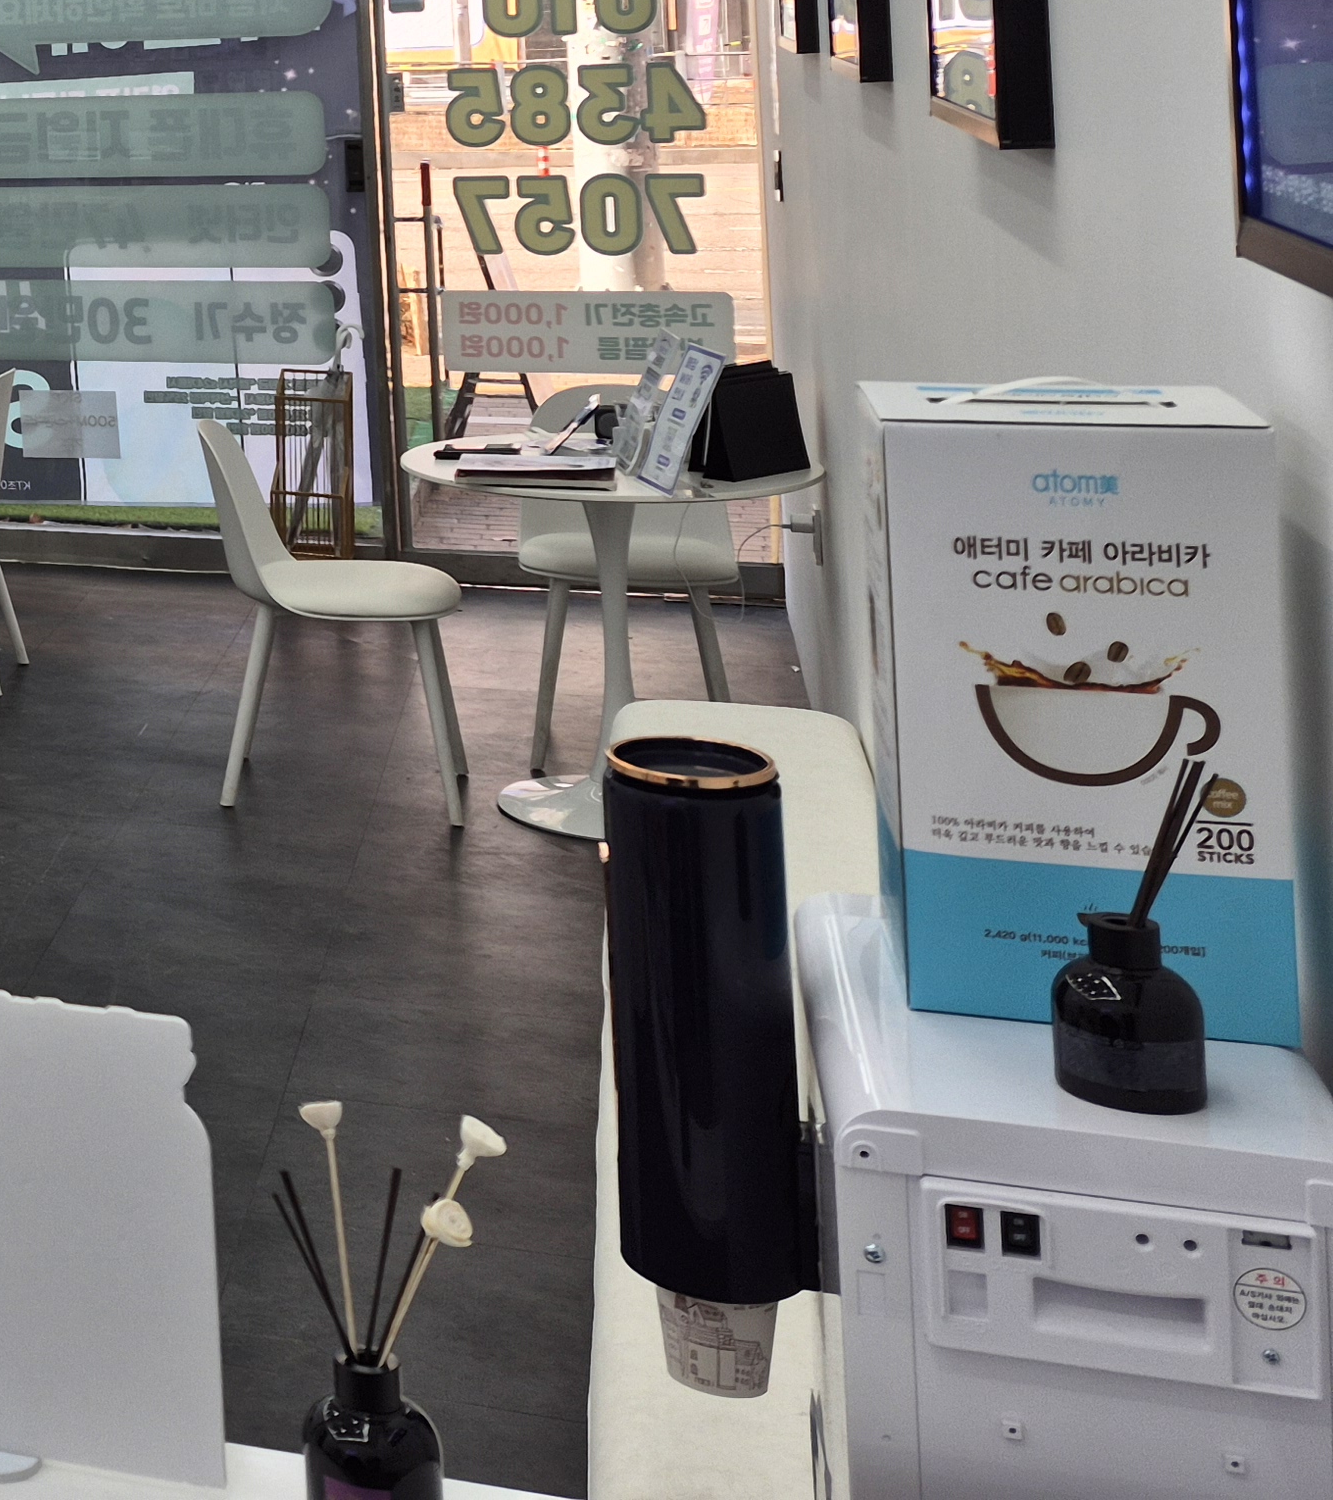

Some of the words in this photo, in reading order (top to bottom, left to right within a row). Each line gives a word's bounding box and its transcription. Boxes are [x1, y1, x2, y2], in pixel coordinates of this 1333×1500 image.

[1049, 496, 1105, 507] ATOMY
[953, 535, 1029, 562] 애터미
[1041, 538, 1093, 564] 카페
[1103, 541, 1211, 569] 아라비카
[972, 565, 1053, 591] cafe
[1059, 571, 1190, 598] arabica
[1207, 788, 1239, 800] offee
[932, 815, 960, 828] 100%
[964, 817, 1008, 832] 아라비카
[1051, 824, 1095, 838] 사용하여
[1196, 827, 1255, 852] 200
[1197, 851, 1255, 865] STICKS
[984, 929, 1016, 941] 2,420
[1073, 935, 1089, 947] kc
[958, 1226, 971, 1234] OFF
[1255, 1273, 1268, 1284] 주
[1273, 1276, 1286, 1288] 의
